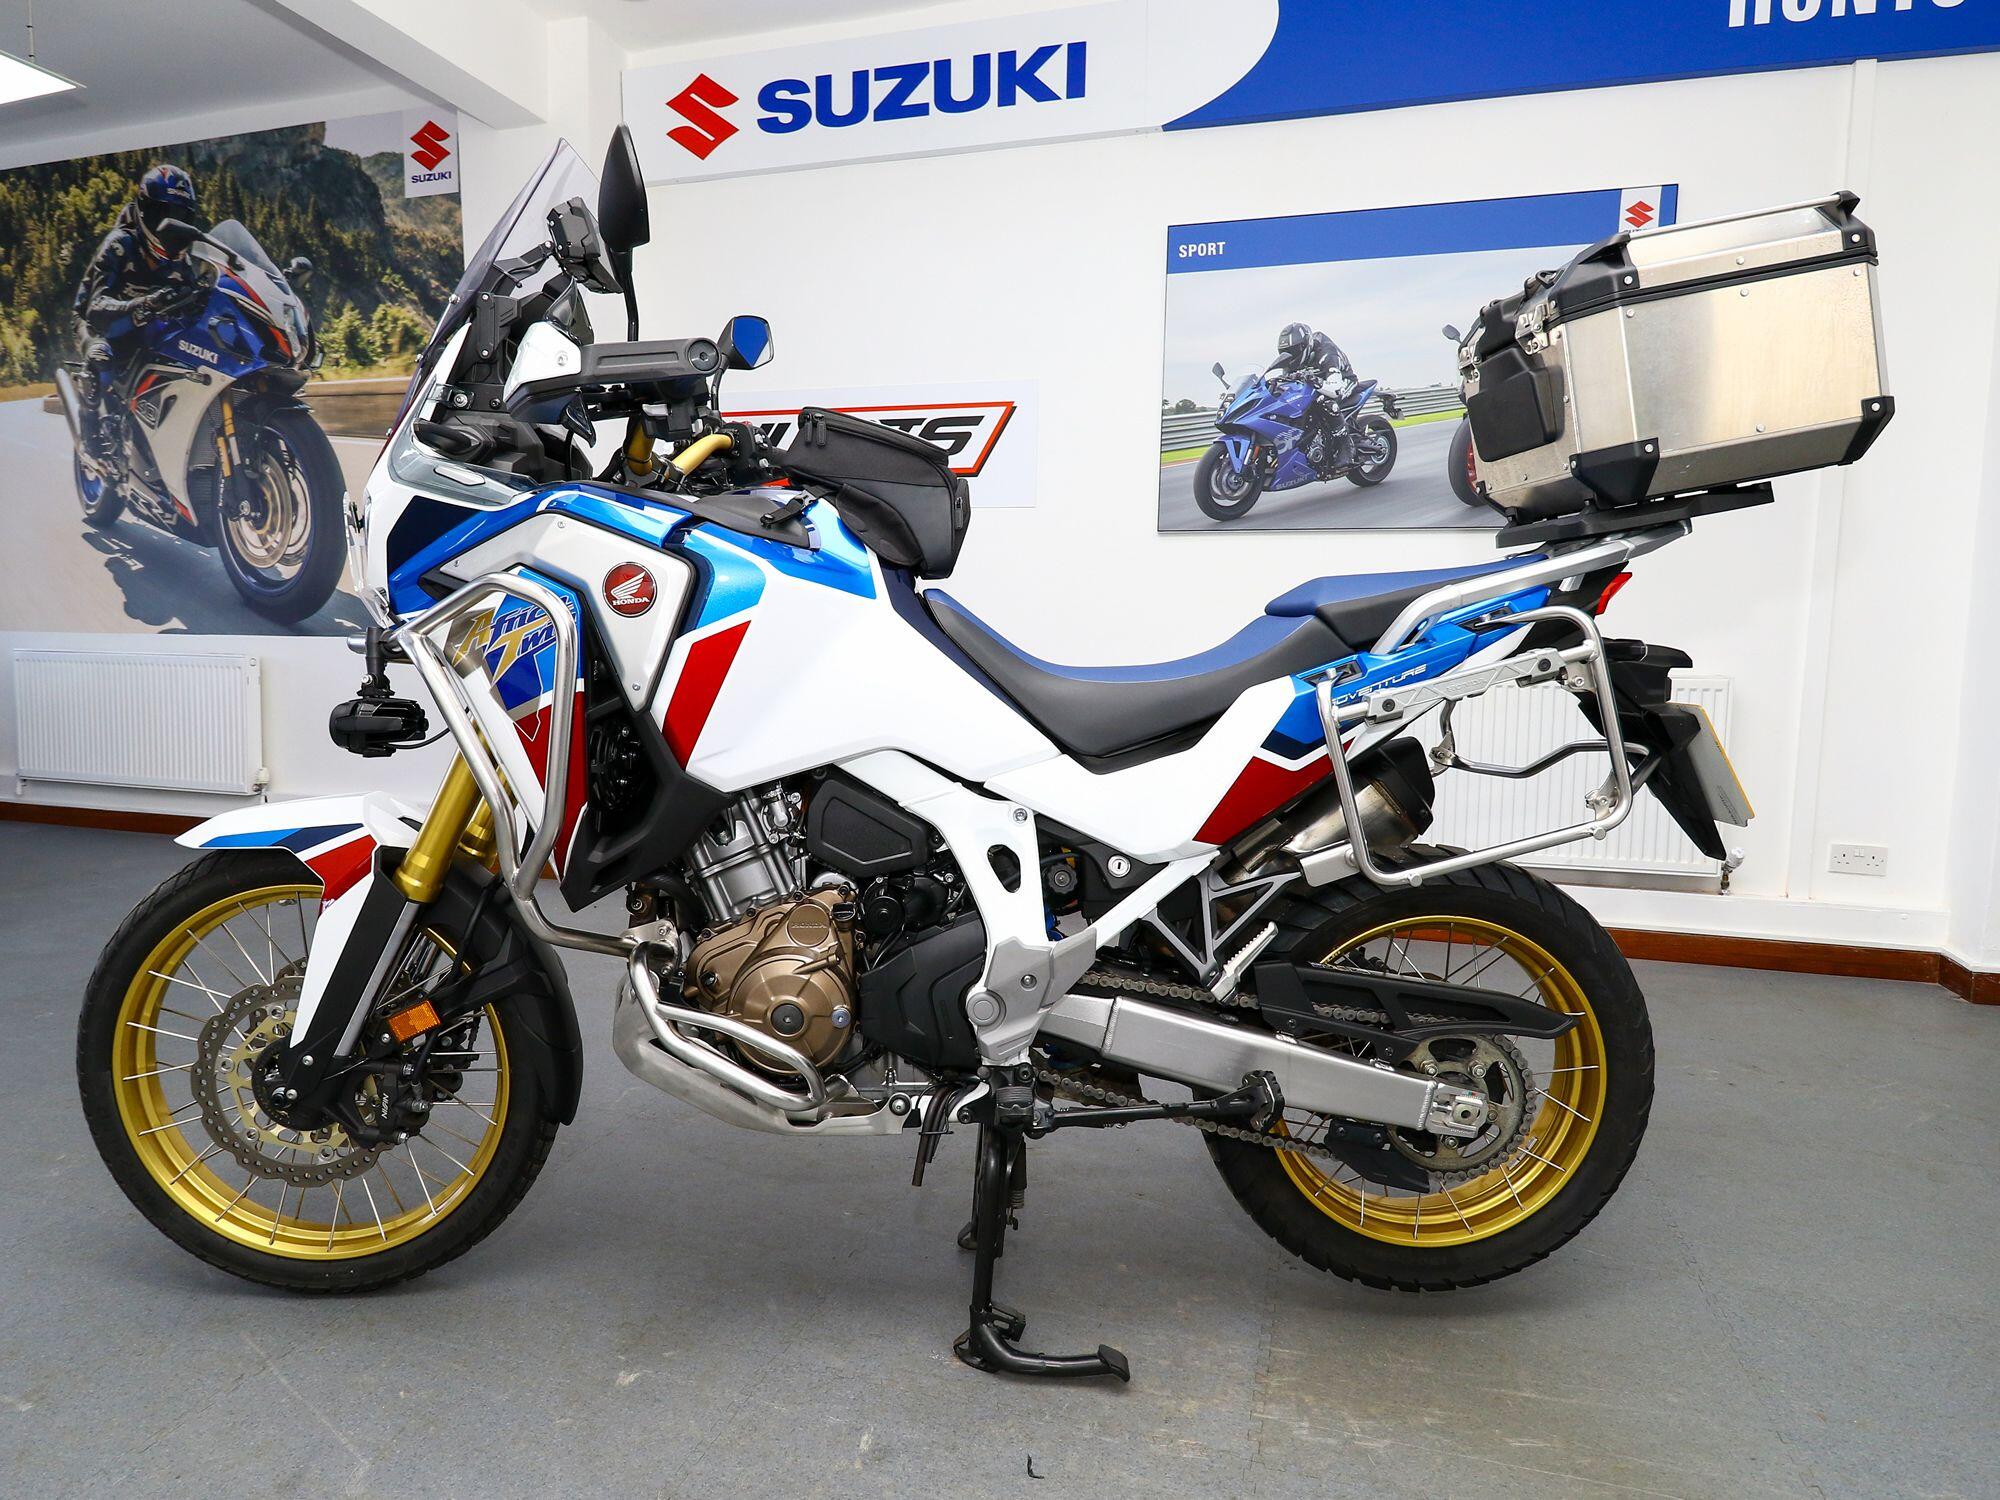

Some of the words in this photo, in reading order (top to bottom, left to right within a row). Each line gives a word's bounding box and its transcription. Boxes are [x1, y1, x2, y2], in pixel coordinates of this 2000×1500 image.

[757, 41, 1086, 134] SUZUKI
[411, 171, 452, 183] SUZUKI
[1178, 241, 1226, 258] SPORT
[178, 339, 219, 364] SUZUKI
[612, 597, 650, 606] HONDA
